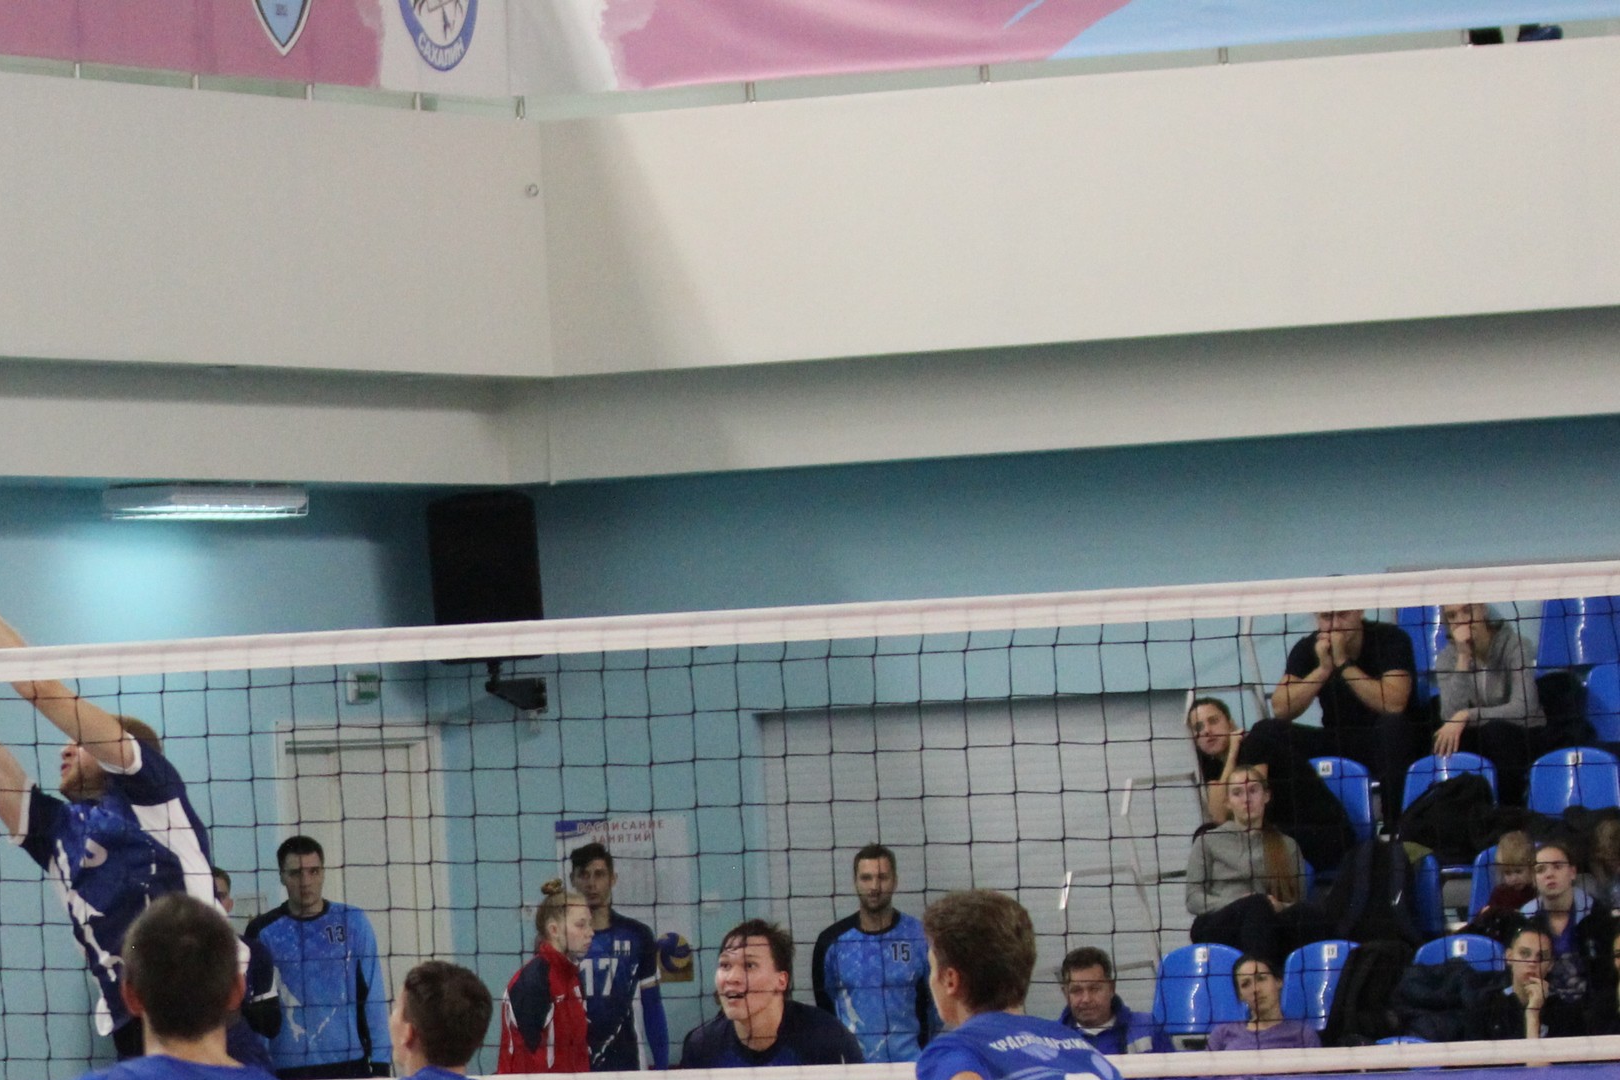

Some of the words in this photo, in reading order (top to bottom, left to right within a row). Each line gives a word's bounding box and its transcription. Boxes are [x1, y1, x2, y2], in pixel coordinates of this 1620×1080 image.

[325, 925, 346, 944] 13
[891, 942, 911, 963] 15
[580, 958, 619, 996] 17
